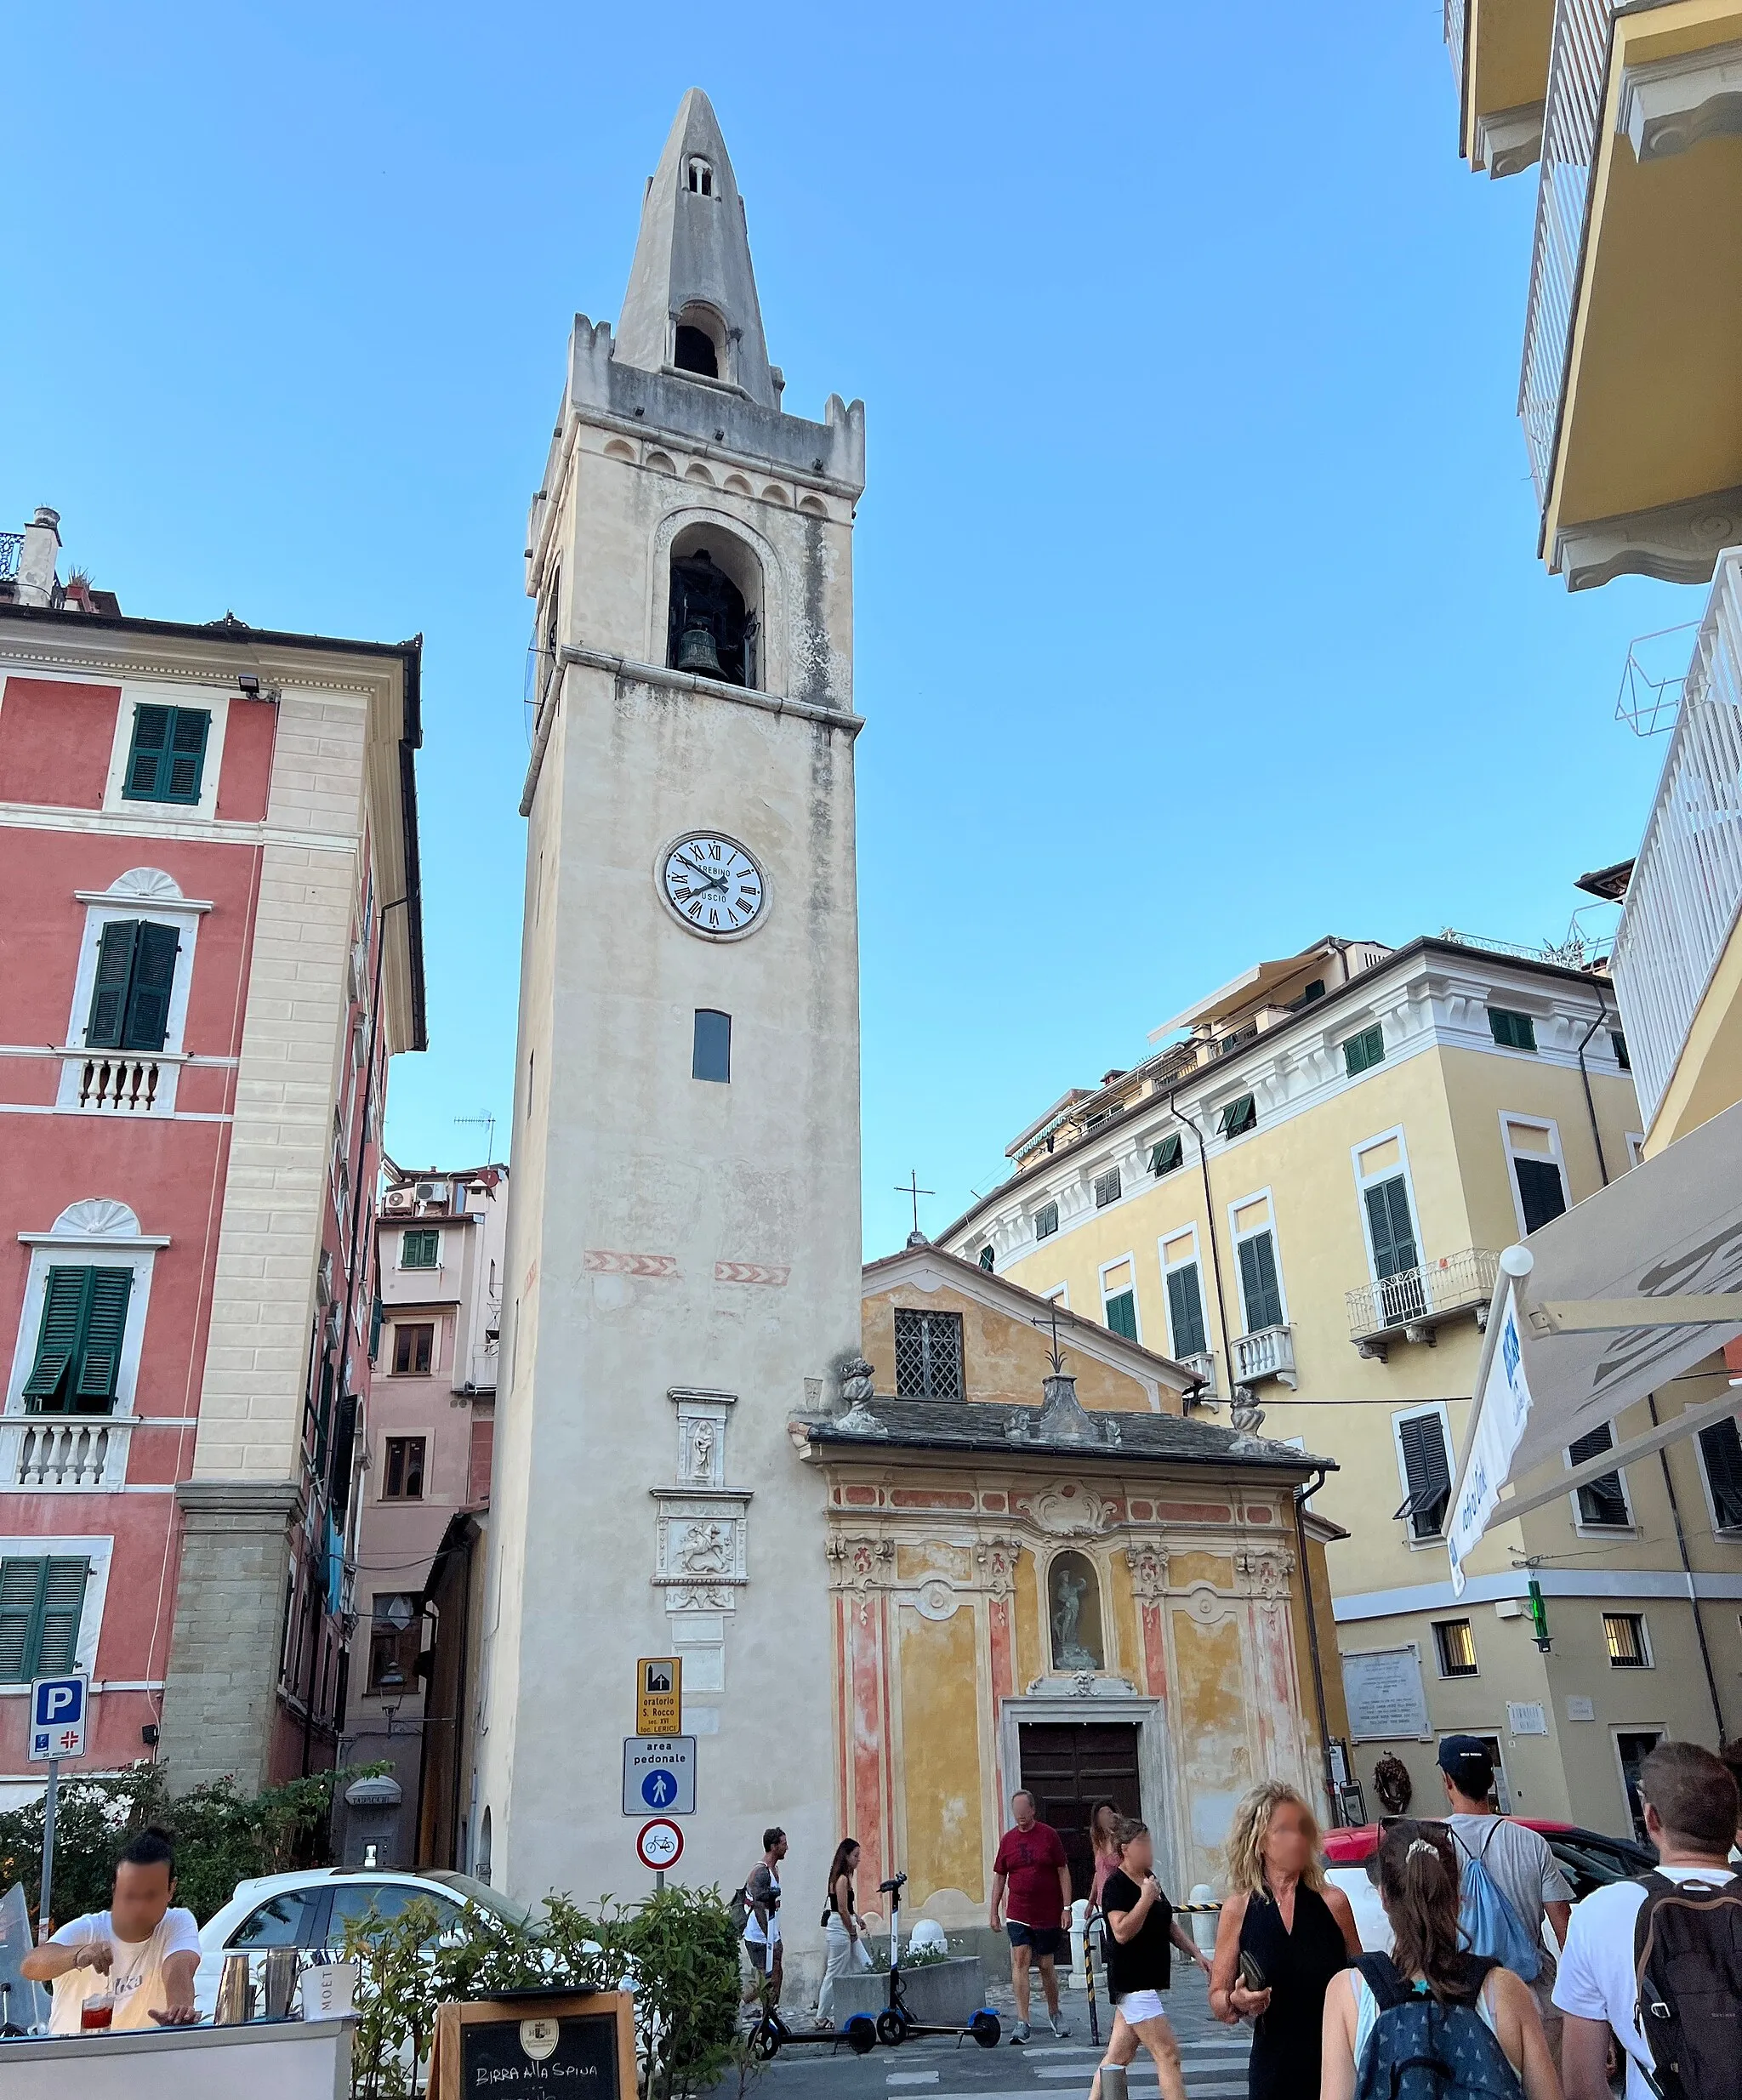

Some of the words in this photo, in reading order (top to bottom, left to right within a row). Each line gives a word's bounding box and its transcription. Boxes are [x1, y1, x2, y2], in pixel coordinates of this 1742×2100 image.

[689, 845, 705, 862] XI
[708, 844, 721, 861] XII
[672, 872, 688, 884] IX
[736, 869, 751, 878] II
[701, 892, 726, 903] USCIO
[741, 885, 756, 896] III
[709, 908, 720, 925] VI
[727, 908, 738, 923] V
[47, 1687, 73, 1720] P
[634, 1754, 686, 1765] pedonale
[476, 2067, 520, 2086] BIRRA
